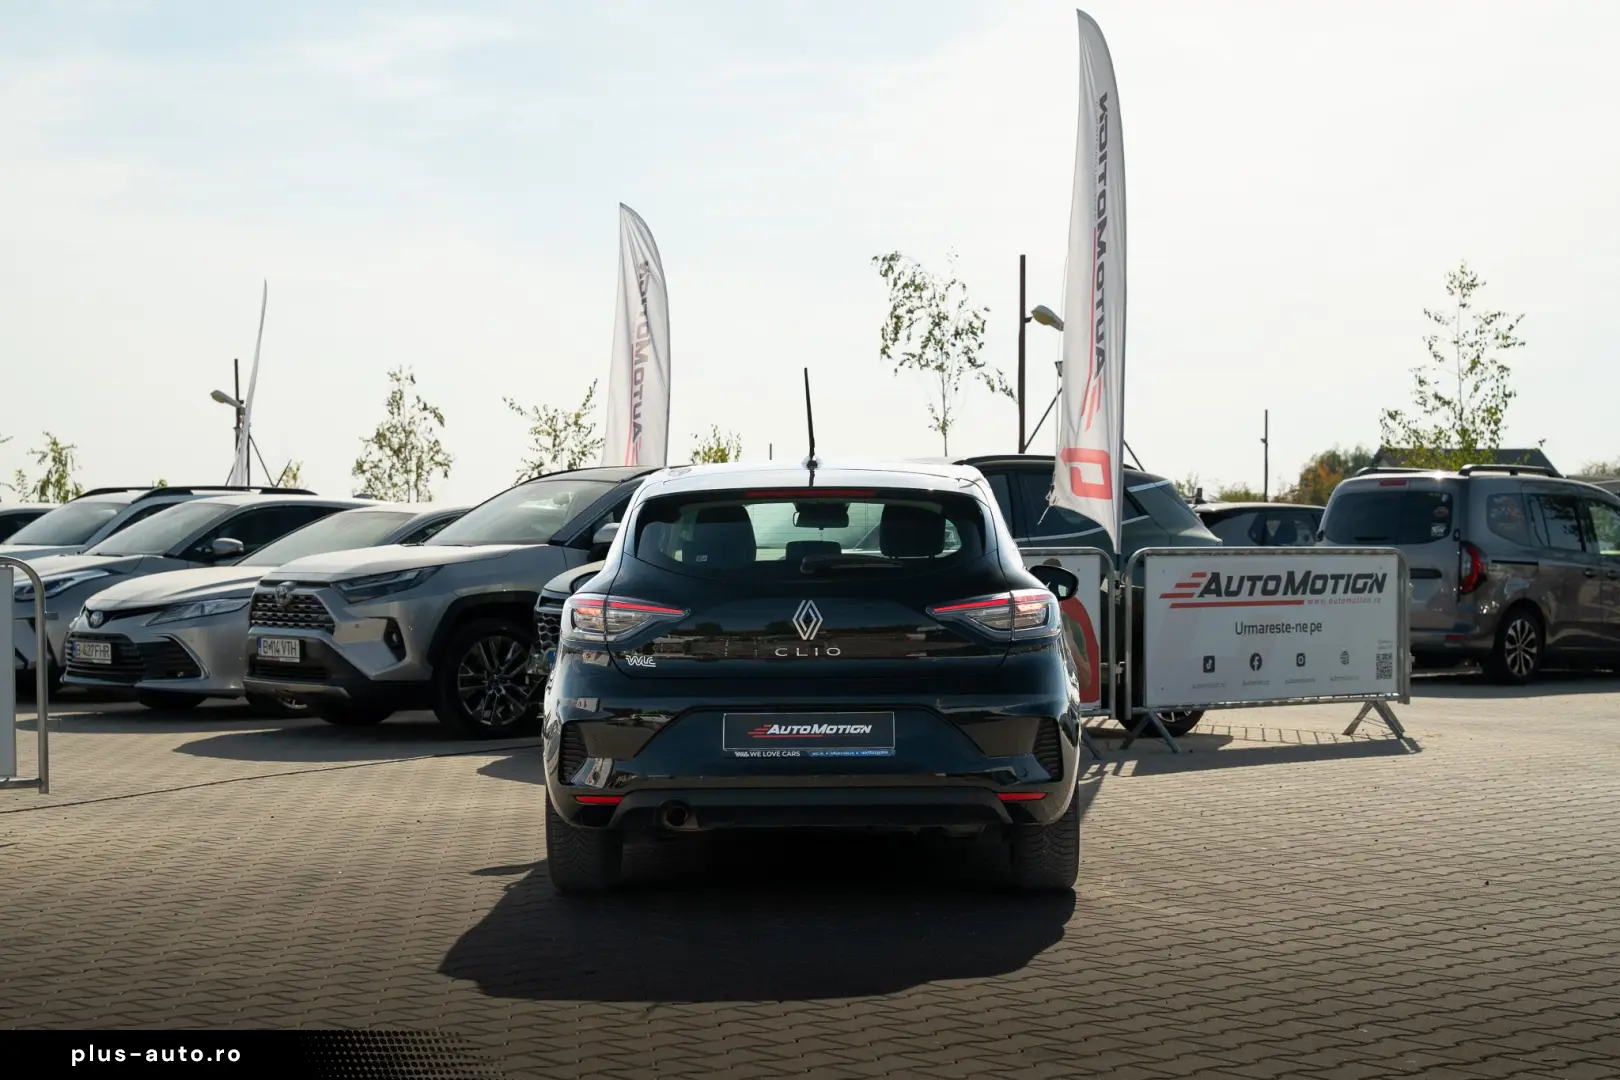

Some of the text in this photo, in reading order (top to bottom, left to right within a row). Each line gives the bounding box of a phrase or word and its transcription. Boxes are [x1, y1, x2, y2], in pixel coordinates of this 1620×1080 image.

[1234, 621, 1323, 636] Urmareste-ne pe
[774, 647, 842, 657] CLIO
